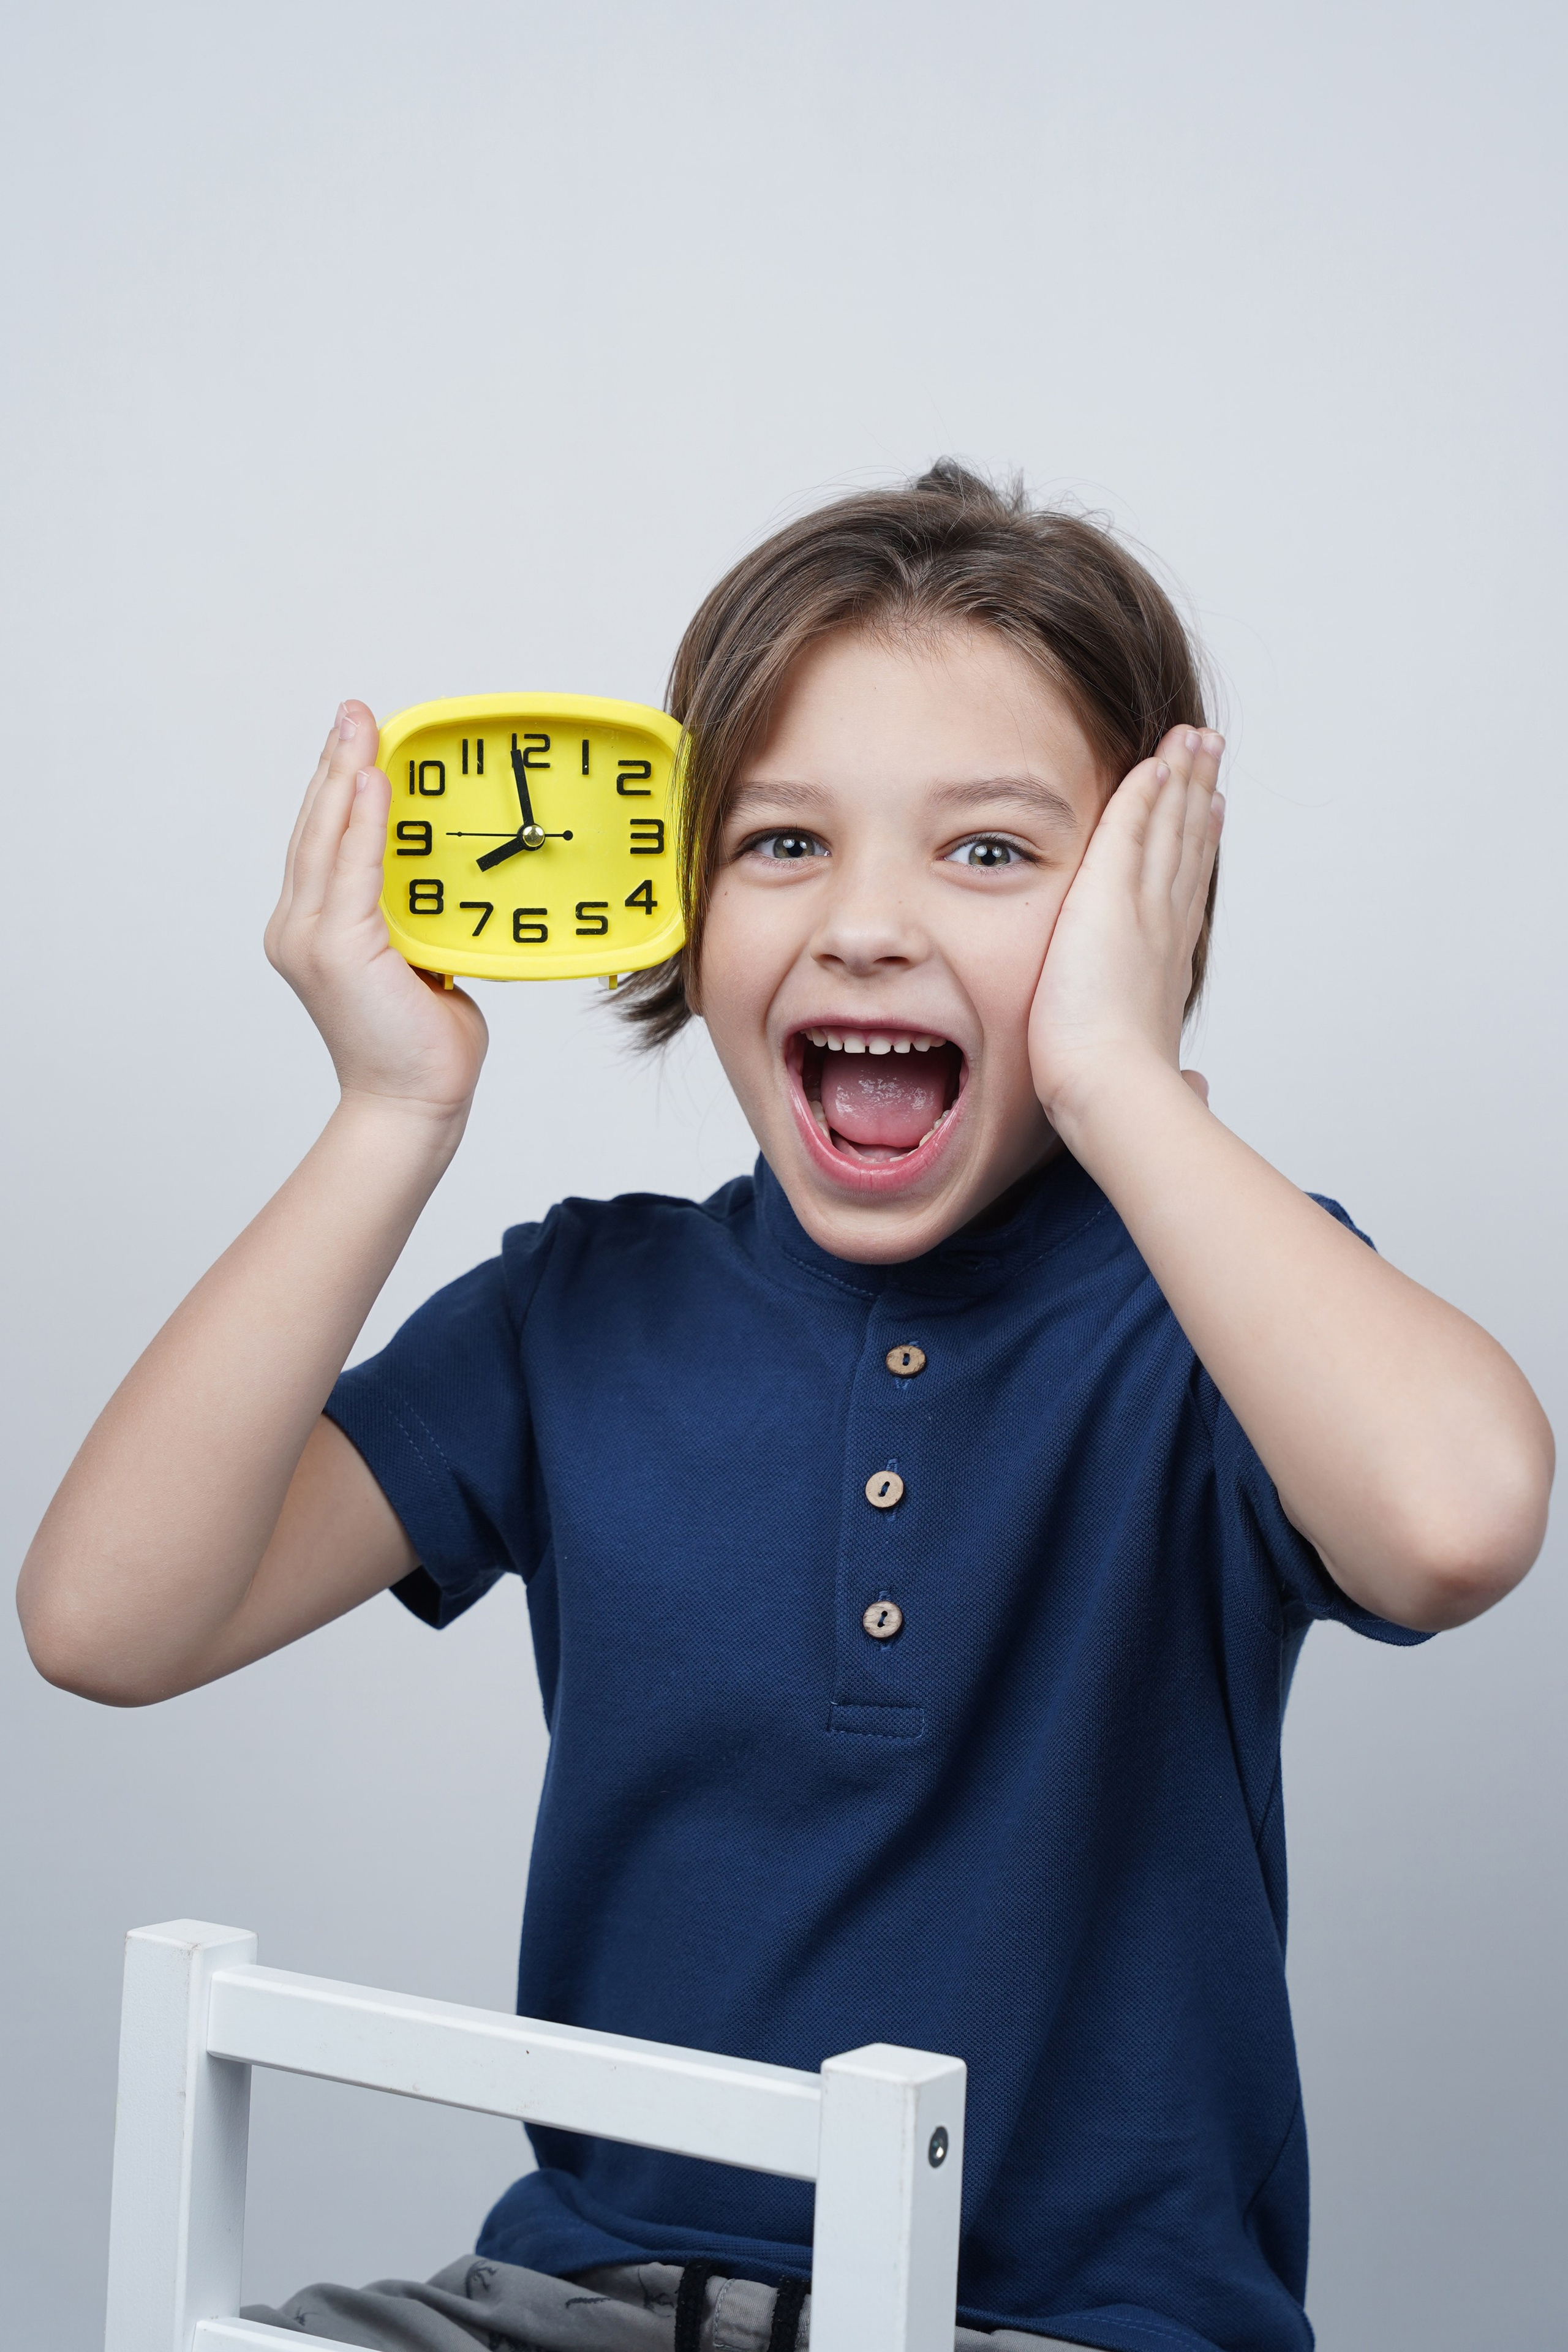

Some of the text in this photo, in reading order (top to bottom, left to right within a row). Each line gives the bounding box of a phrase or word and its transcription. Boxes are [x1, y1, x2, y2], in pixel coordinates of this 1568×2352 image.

[462, 738, 484, 775] 11
[581, 739, 589, 775] 1
[409, 760, 446, 796] 10
[616, 760, 652, 796] 2
[396, 820, 432, 856] 9
[630, 818, 665, 854] 3
[409, 878, 444, 915] 8
[624, 880, 658, 915] 4
[459, 901, 494, 937] 7
[513, 908, 548, 943] 6
[575, 902, 609, 935] 5
